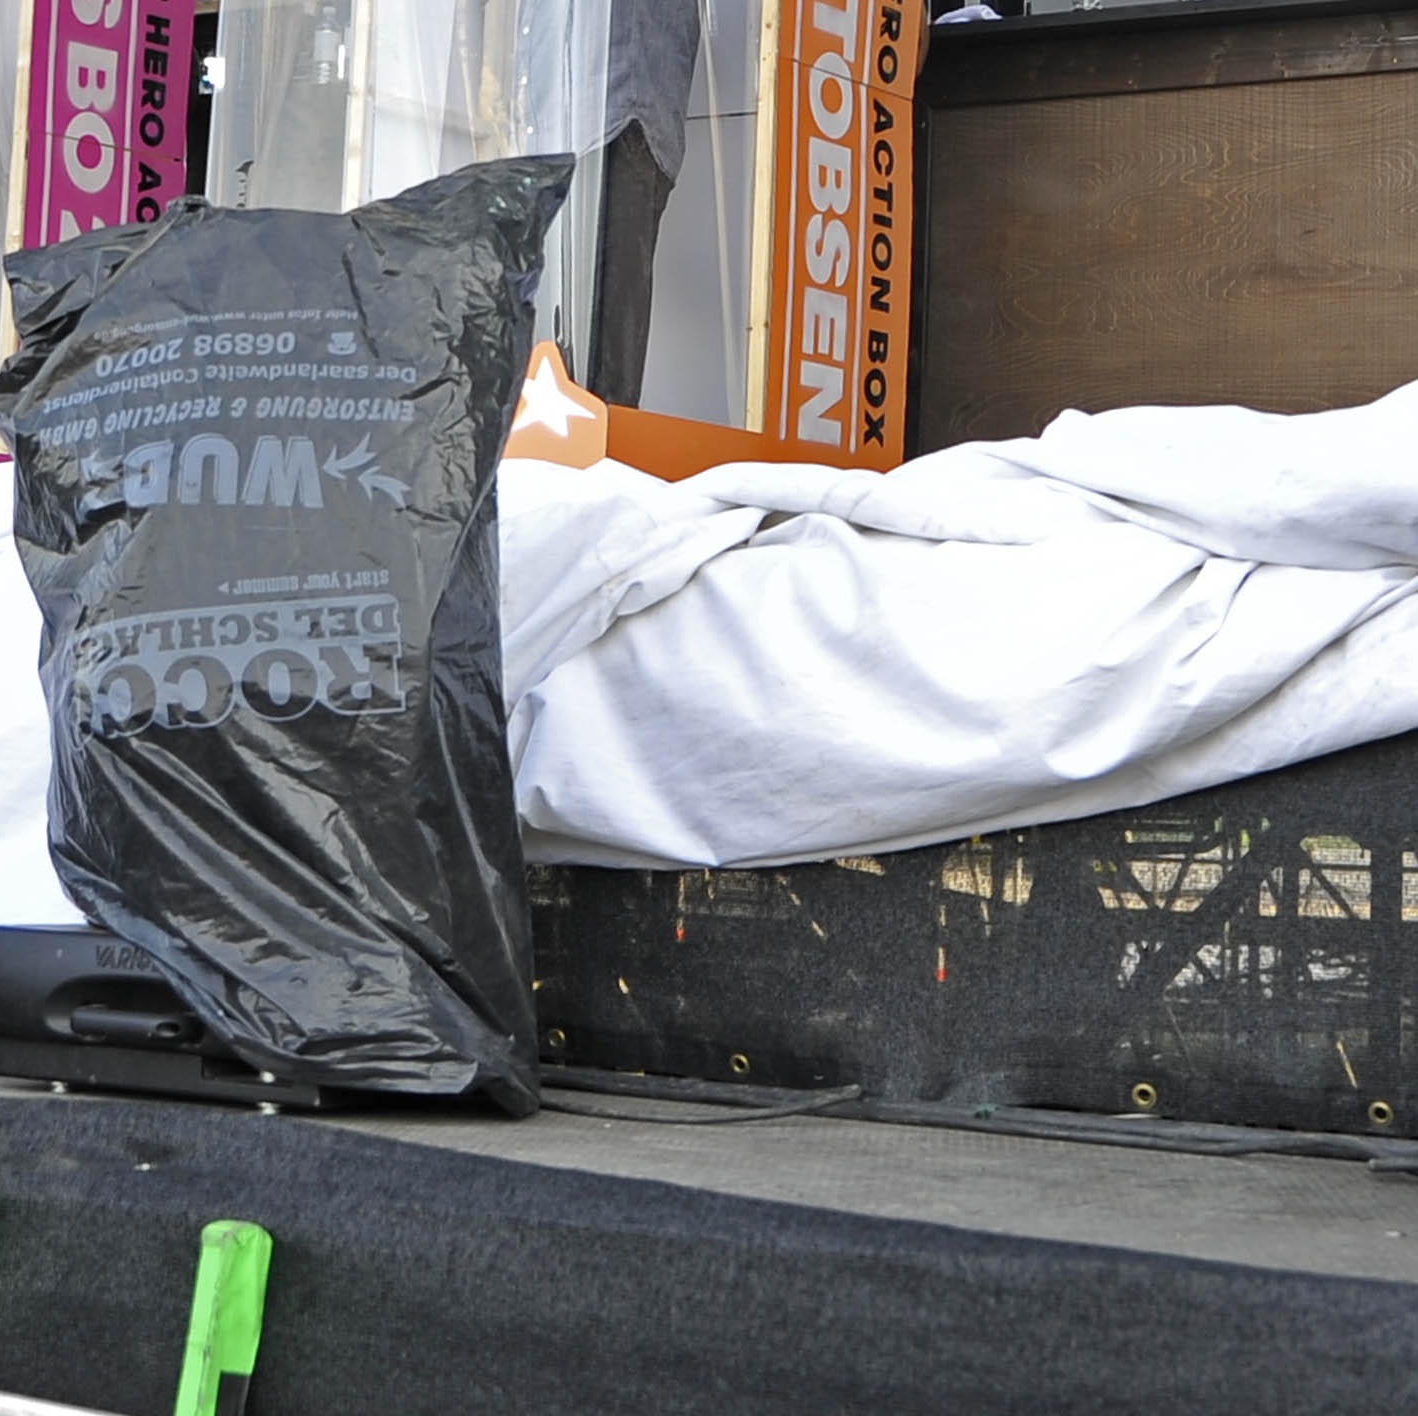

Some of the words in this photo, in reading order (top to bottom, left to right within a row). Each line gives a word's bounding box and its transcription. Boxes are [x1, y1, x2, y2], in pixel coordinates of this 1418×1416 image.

[139, 14, 171, 148] HERO
[62, 40, 119, 194] BO
[870, 97, 895, 314] ACTION
[249, 310, 284, 322] unter
[94, 336, 184, 377] 20070
[193, 331, 296, 358] 06898
[42, 367, 199, 411] Containerdienst
[205, 363, 369, 385] saarlandweite
[375, 365, 417, 384] Der
[863, 328, 889, 448] BOX
[103, 396, 222, 435] RECYCLING
[230, 397, 247, 418] &
[255, 396, 415, 423] ENTSORGUNG
[303, 570, 341, 593] your
[344, 569, 389, 593] start
[292, 602, 397, 638] DEL
